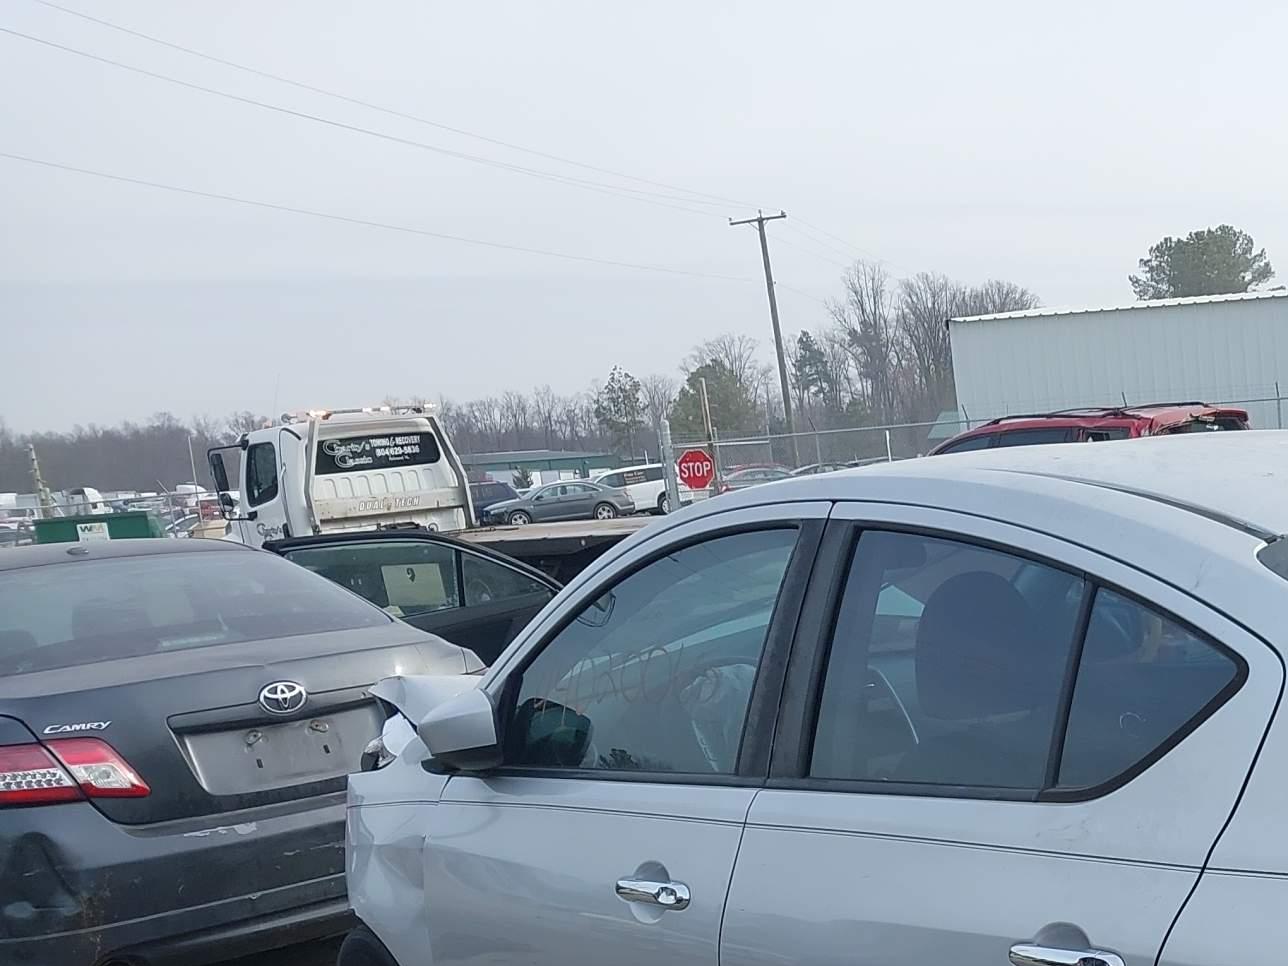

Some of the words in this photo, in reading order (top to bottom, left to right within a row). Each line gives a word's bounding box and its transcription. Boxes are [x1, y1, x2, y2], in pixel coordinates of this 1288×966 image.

[395, 434, 420, 445] RECOVERY
[680, 461, 711, 478] STOP
[358, 500, 384, 512] DUAL
[395, 496, 421, 507] TECH
[43, 720, 112, 734] CAMRY
